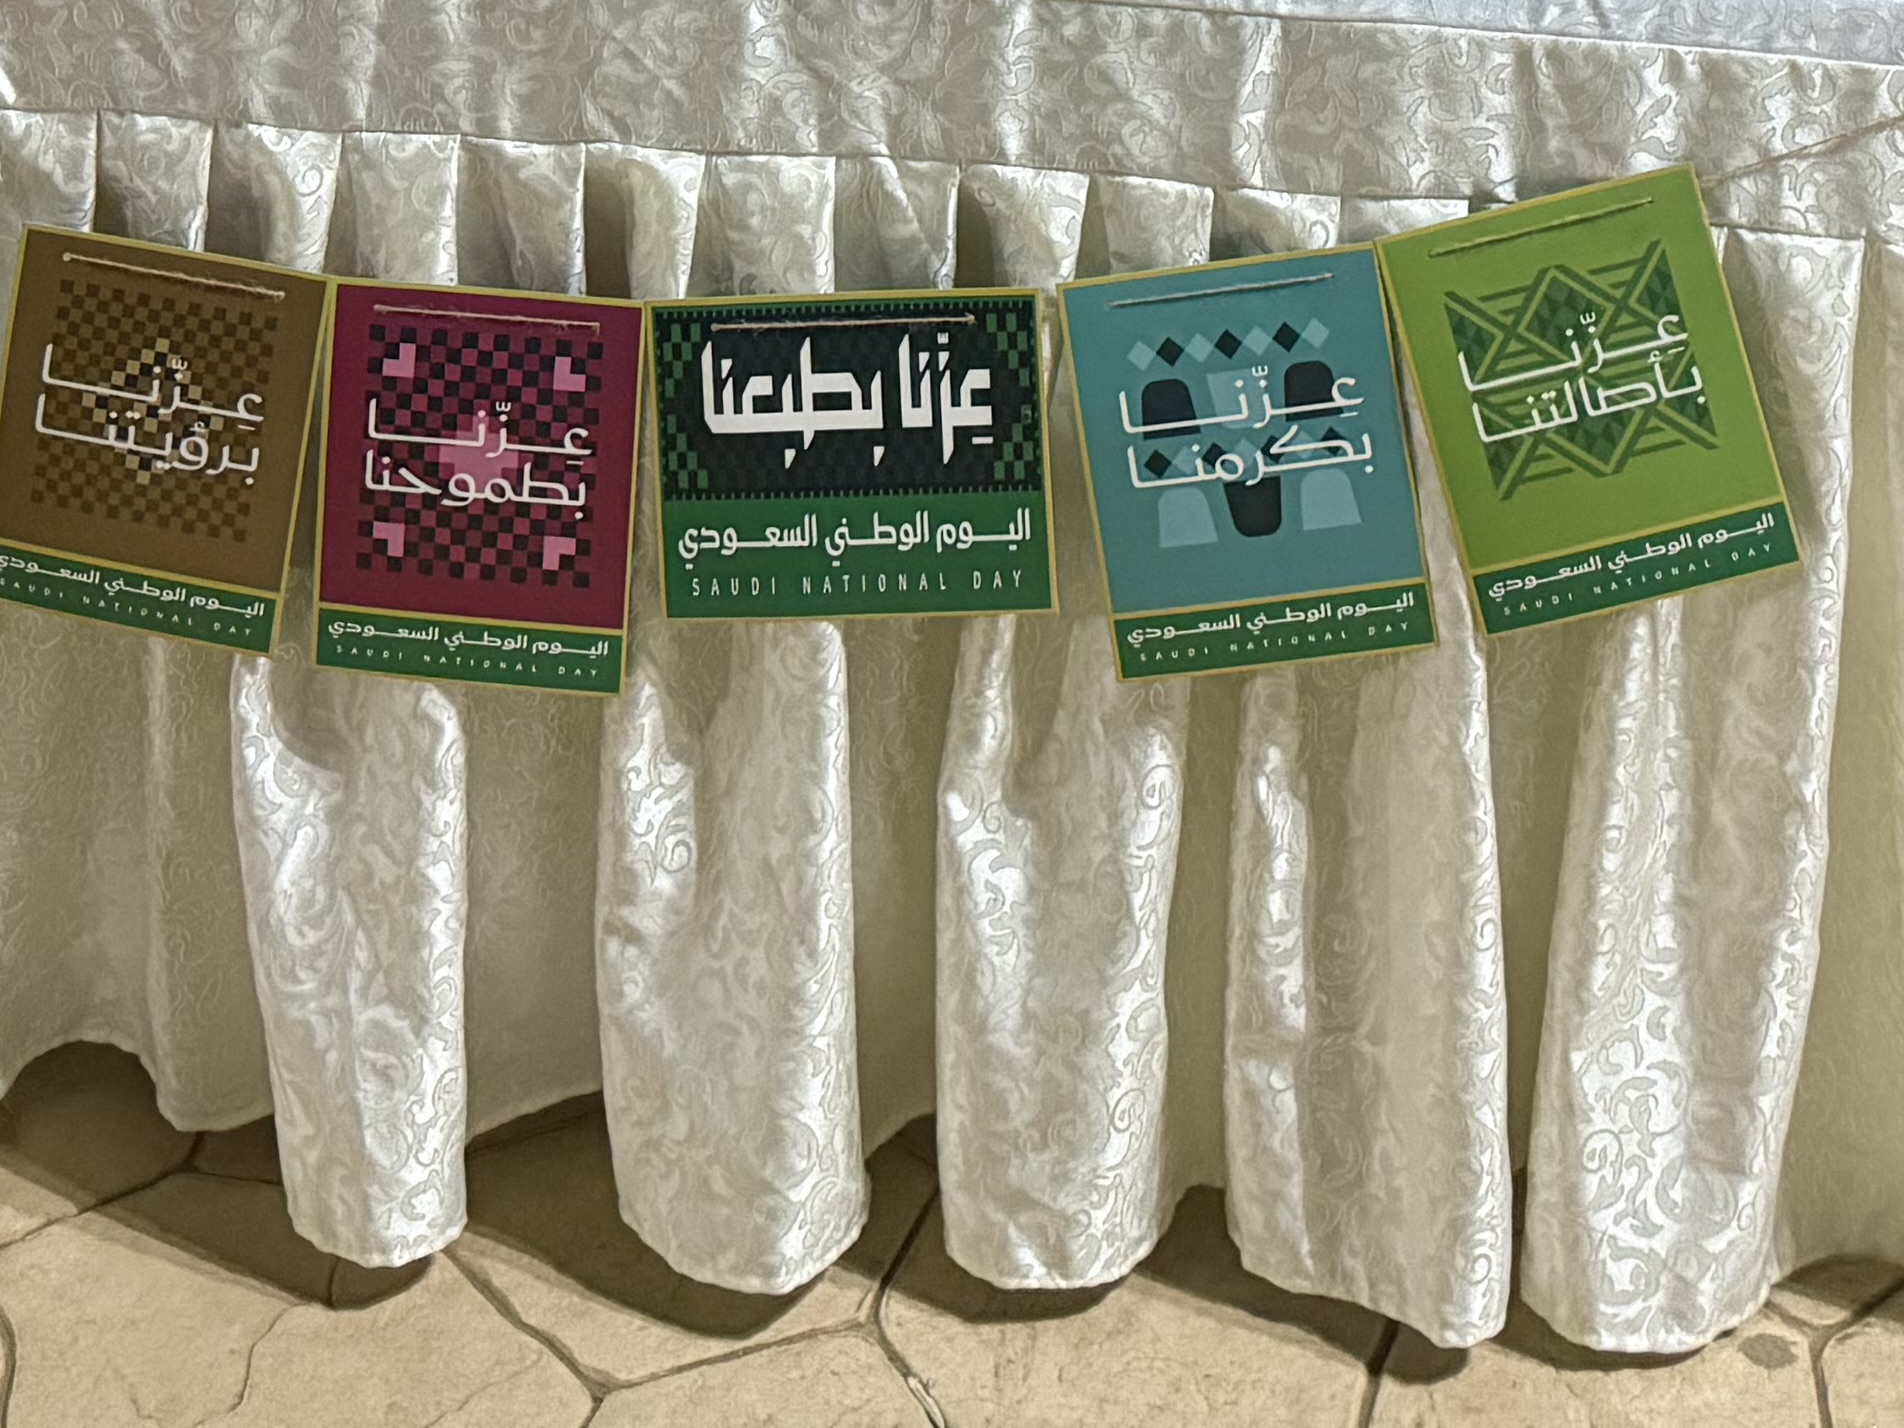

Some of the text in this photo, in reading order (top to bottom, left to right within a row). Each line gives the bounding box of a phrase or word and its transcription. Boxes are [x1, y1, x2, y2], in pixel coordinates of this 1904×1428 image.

[700, 336, 885, 470] بطبعنا
[1472, 350, 1706, 443] بأصالتنا
[35, 393, 260, 485] برؤيتنا
[1127, 424, 1374, 489] بكرمنا
[364, 449, 586, 520] بطموحنا
[677, 507, 1031, 570] اليوم الوطني السعودي
[1488, 512, 1775, 602] اليوم الوطني السعودي
[0, 578, 252, 637] SAUDI NATIONAL DAY
[103, 578, 186, 603] الوطني
[189, 596, 265, 618] اليوم
[692, 569, 1022, 596] SAUDI NATIONAL DAY
[1503, 543, 1772, 616] SAUDI NATIONAL DAY
[328, 620, 609, 659] اليوم الوطني السعودي
[1127, 592, 1415, 648] اليوم الوطني السعودي
[1140, 621, 1409, 662] SAUDI NATIONAL DAY
[336, 644, 598, 678] SAUDI NATIONAL DAY
